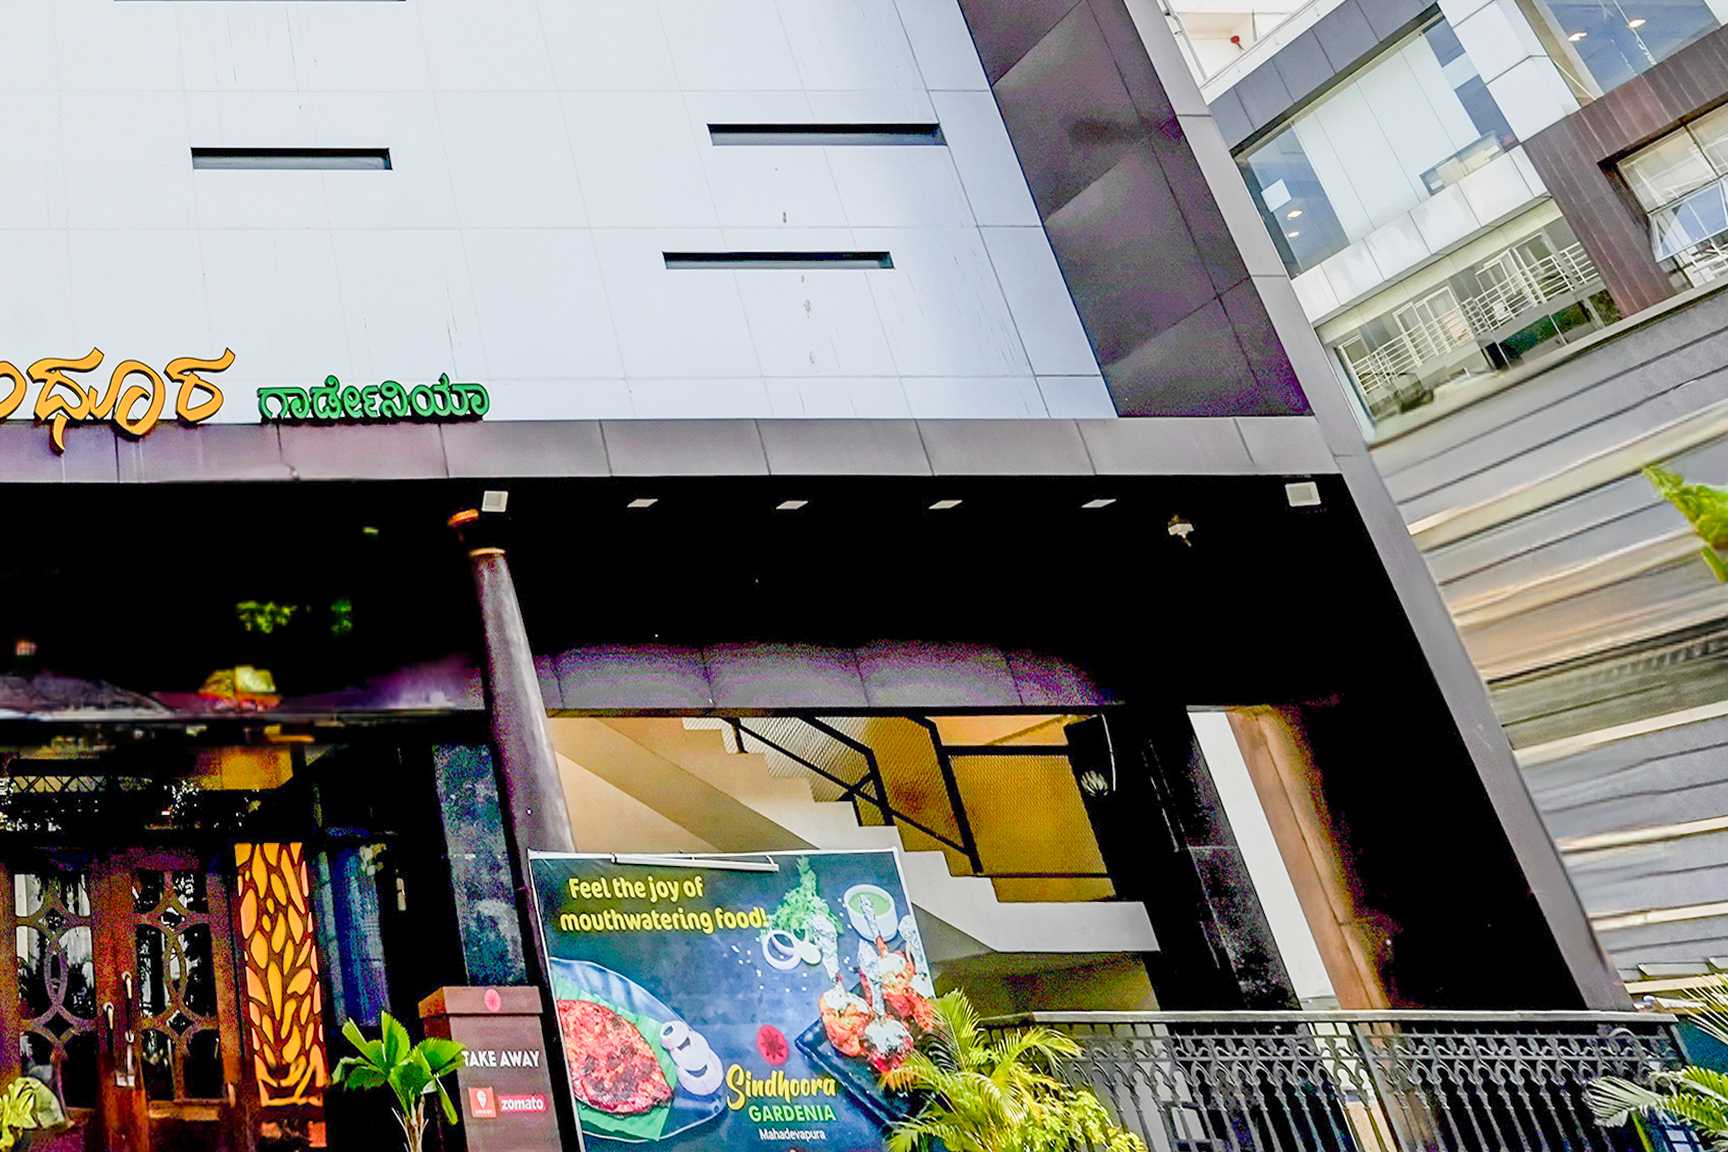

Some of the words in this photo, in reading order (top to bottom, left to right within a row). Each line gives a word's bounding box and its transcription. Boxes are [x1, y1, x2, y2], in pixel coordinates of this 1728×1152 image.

[568, 877, 611, 899] Feel
[612, 876, 646, 899] the
[647, 876, 679, 903] joy
[682, 876, 704, 898] of
[560, 907, 714, 934] mouthwatering
[714, 906, 770, 930] food!
[461, 1050, 497, 1067] TAKE
[500, 1050, 540, 1067] AWAY
[725, 1063, 837, 1110] Sindhoora
[501, 1096, 544, 1111] zomato
[749, 1104, 836, 1122] GARDENIA
[759, 1128, 826, 1142] Mahadevapura
